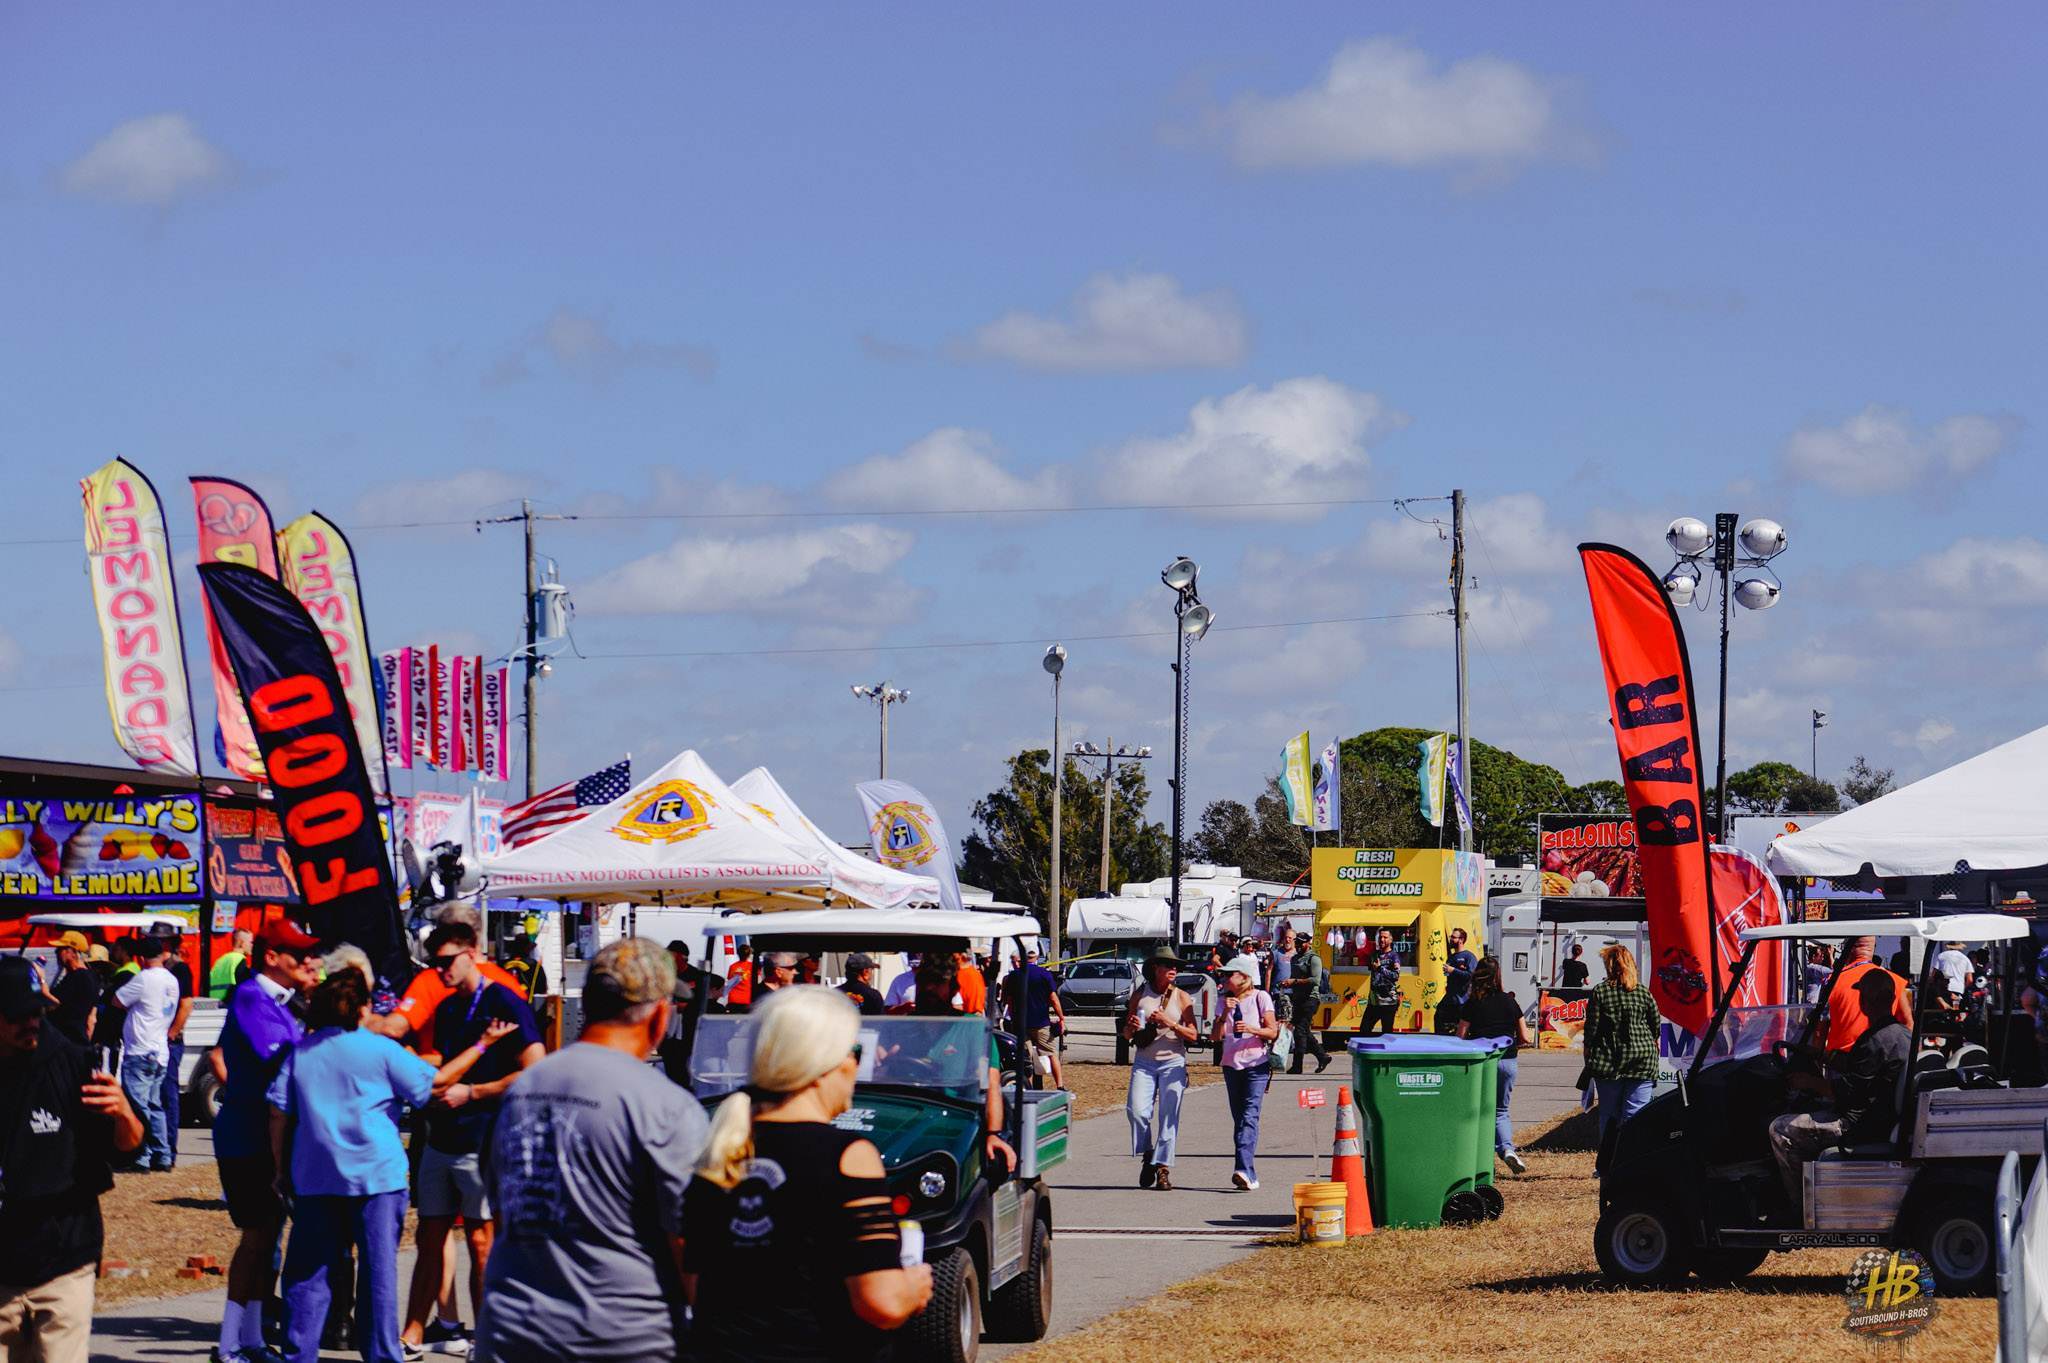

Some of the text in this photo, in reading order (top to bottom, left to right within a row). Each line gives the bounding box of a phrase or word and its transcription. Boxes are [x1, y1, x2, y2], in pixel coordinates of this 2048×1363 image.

[1614, 674, 1700, 846] BAR
[250, 674, 380, 905] FOOD
[63, 799, 198, 832] WILLY'S
[1544, 822, 1617, 849] SIRLOIN
[1355, 851, 1394, 862] FRESH
[53, 861, 199, 895] LEMONADE
[493, 863, 822, 886] CHRISTIAN MOTORCYCLISTS ASSOCIATION
[1338, 867, 1400, 880] SQUEEZED
[1355, 884, 1422, 895] LEMONADE
[1489, 879, 1522, 888] Jayco
[1399, 1073, 1442, 1084] WASTE PRO
[1779, 1233, 1880, 1246] CARRYALL 300
